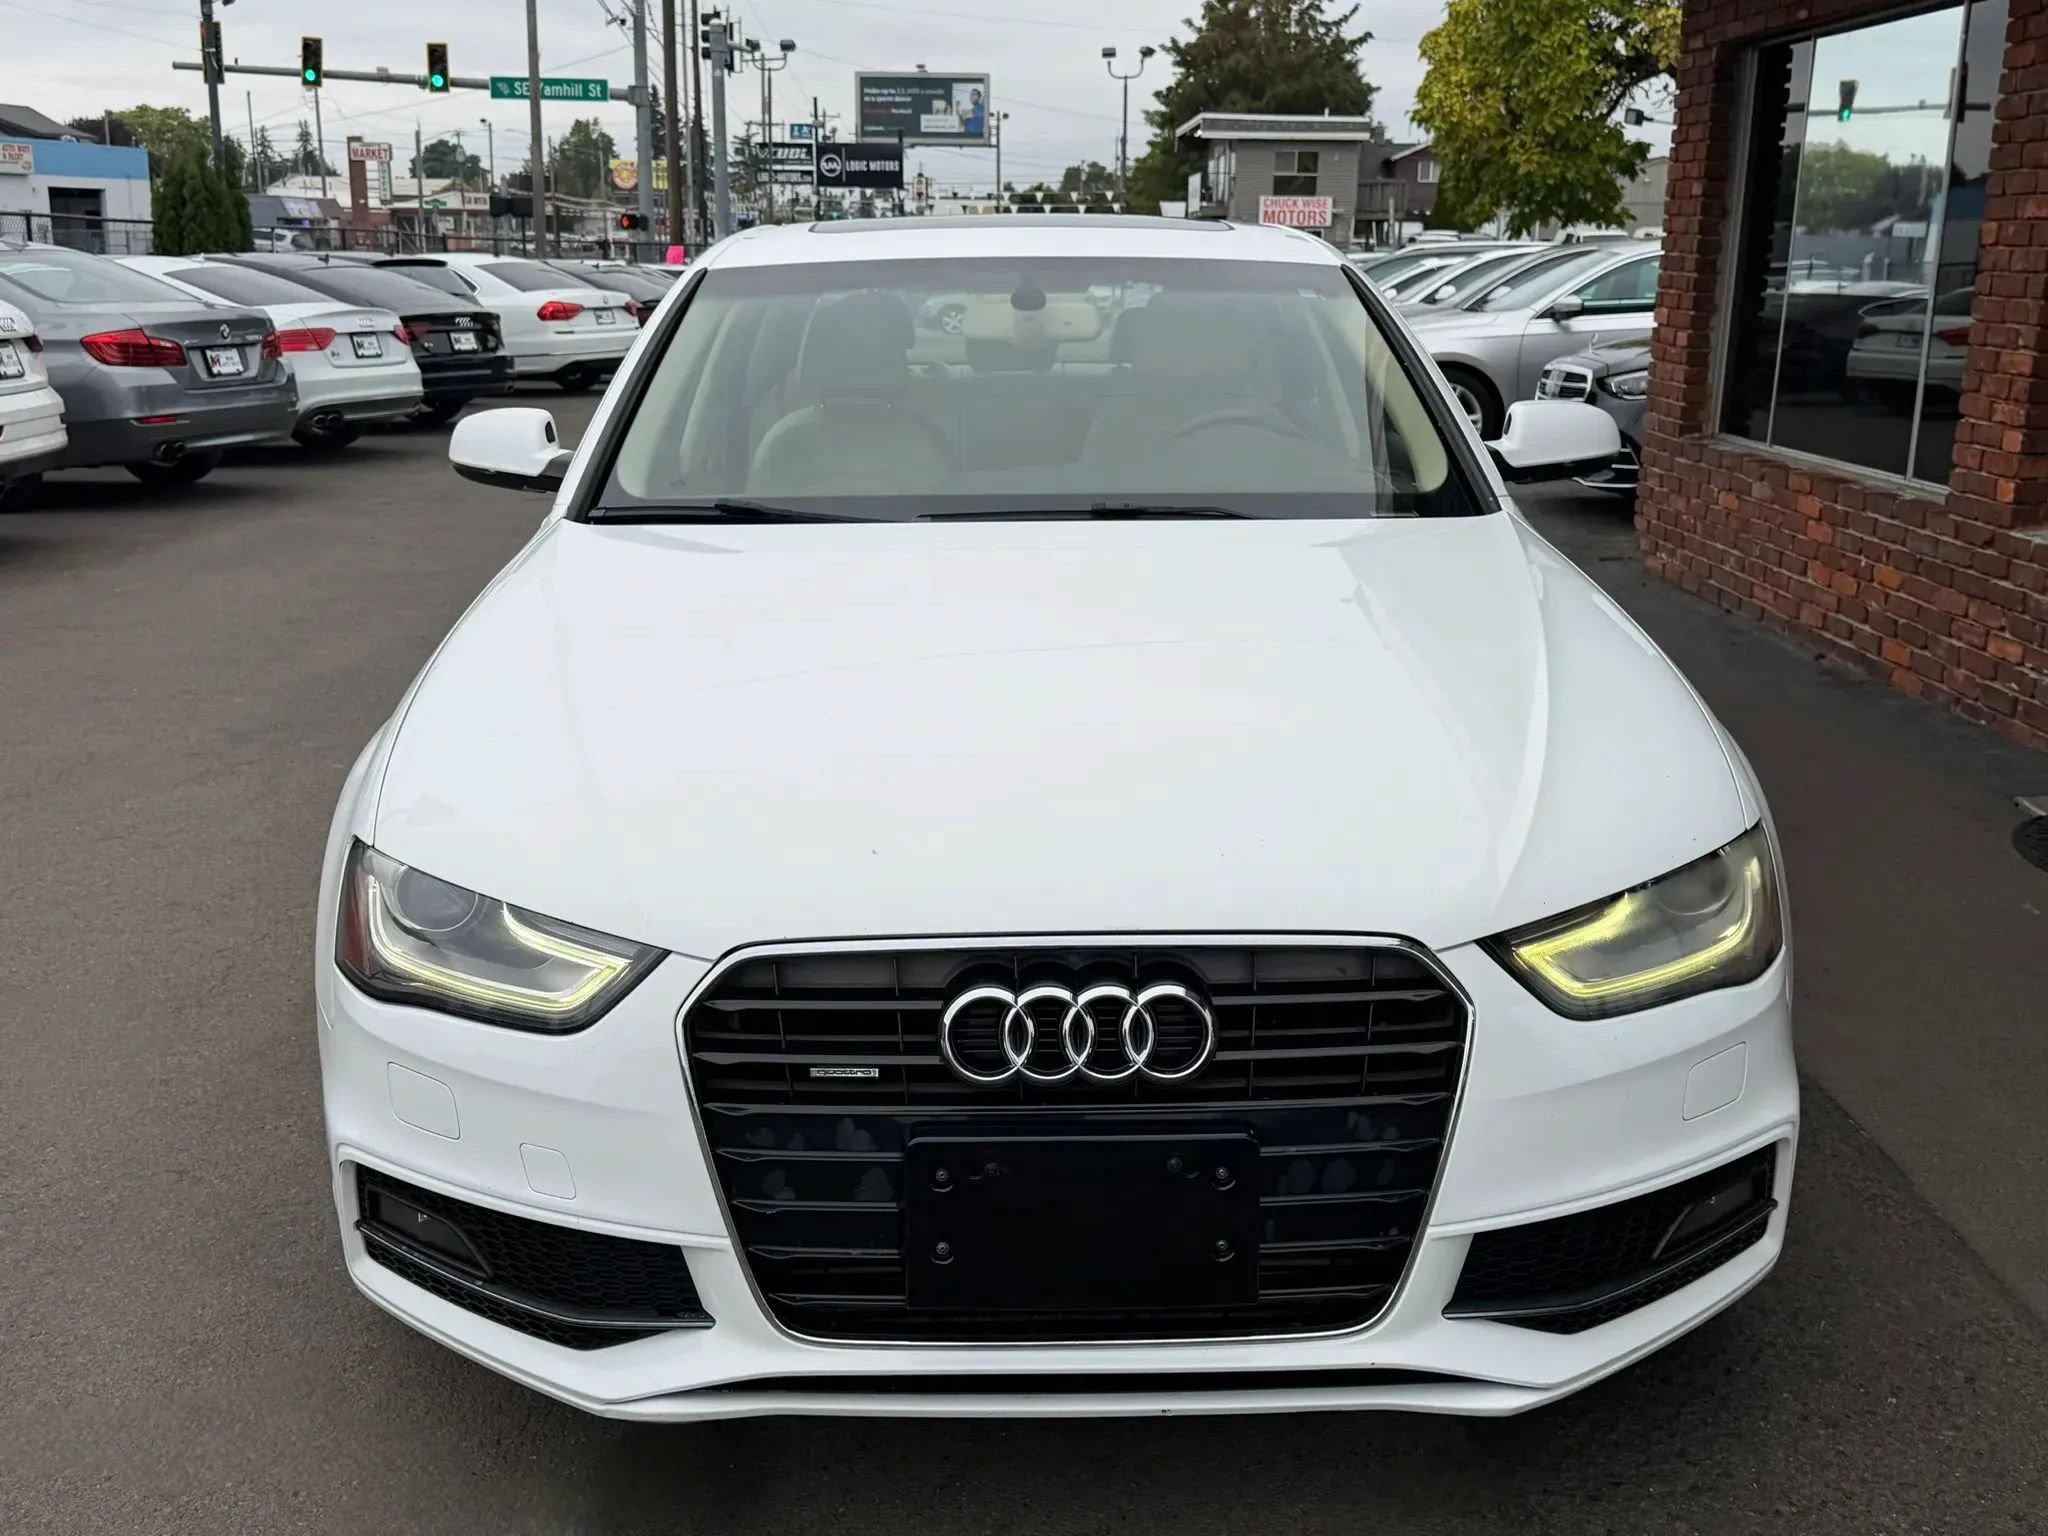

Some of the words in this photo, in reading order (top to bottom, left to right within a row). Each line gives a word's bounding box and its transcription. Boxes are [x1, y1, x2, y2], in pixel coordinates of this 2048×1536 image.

[514, 81, 530, 95] SE
[588, 84, 602, 98] St
[351, 148, 388, 160] MARKET
[845, 160, 868, 172] LOGIC
[868, 160, 900, 172] MOTORS
[1263, 198, 1297, 209] CHUCK
[1302, 199, 1329, 210] WISE
[1263, 210, 1327, 225] MOTORS
[816, 1068, 874, 1077] quattro
